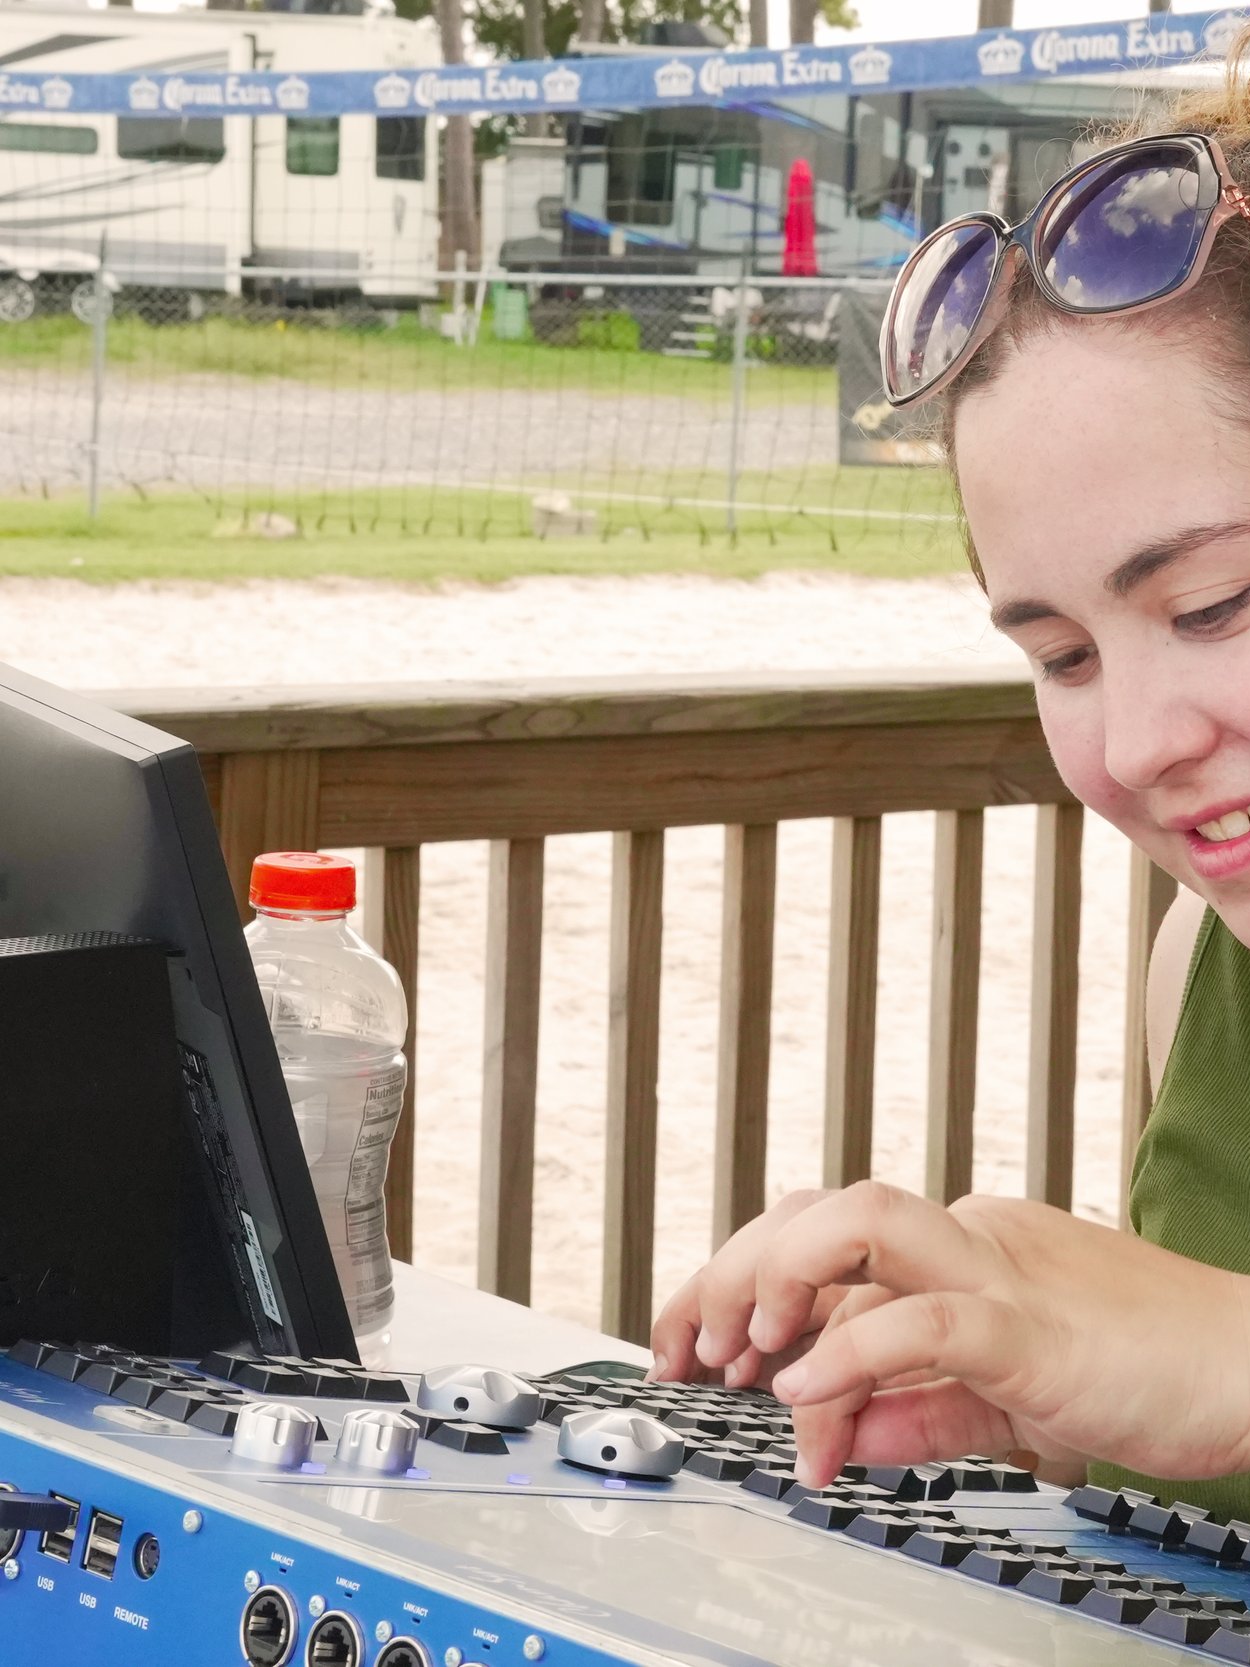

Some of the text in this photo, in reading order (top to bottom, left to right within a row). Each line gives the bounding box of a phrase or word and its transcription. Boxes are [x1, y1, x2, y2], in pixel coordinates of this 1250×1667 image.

[1031, 21, 1195, 73] Corona Extra
[699, 52, 842, 97] Corona Extra
[162, 75, 272, 112] Corona Extra
[414, 69, 538, 109] Corona Extra
[270, 1552, 294, 1567] LNK/ACT
[37, 1575, 55, 1592] USB
[336, 1576, 360, 1592] LNK/ACT
[79, 1592, 97, 1609] USB
[114, 1606, 149, 1630] REMOTE
[403, 1602, 428, 1617] LNK/ACT
[473, 1628, 499, 1644] LNK/ACT
